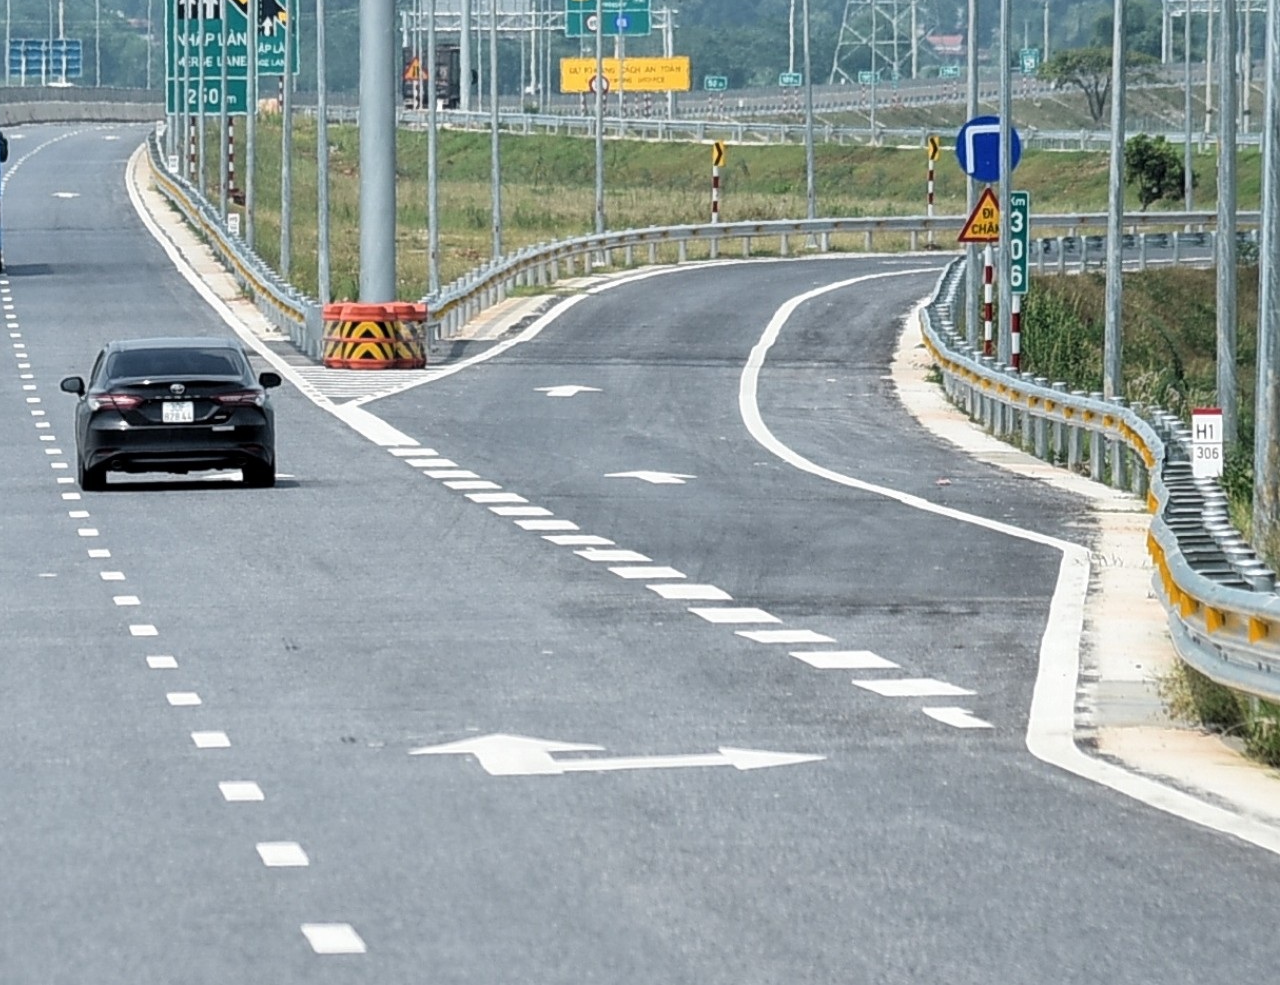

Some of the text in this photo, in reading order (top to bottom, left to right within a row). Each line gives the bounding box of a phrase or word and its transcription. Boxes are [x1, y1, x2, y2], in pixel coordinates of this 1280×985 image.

[982, 207, 994, 219] ĐI
[1196, 423, 1214, 440] H1
[1196, 446, 1220, 460] 306
